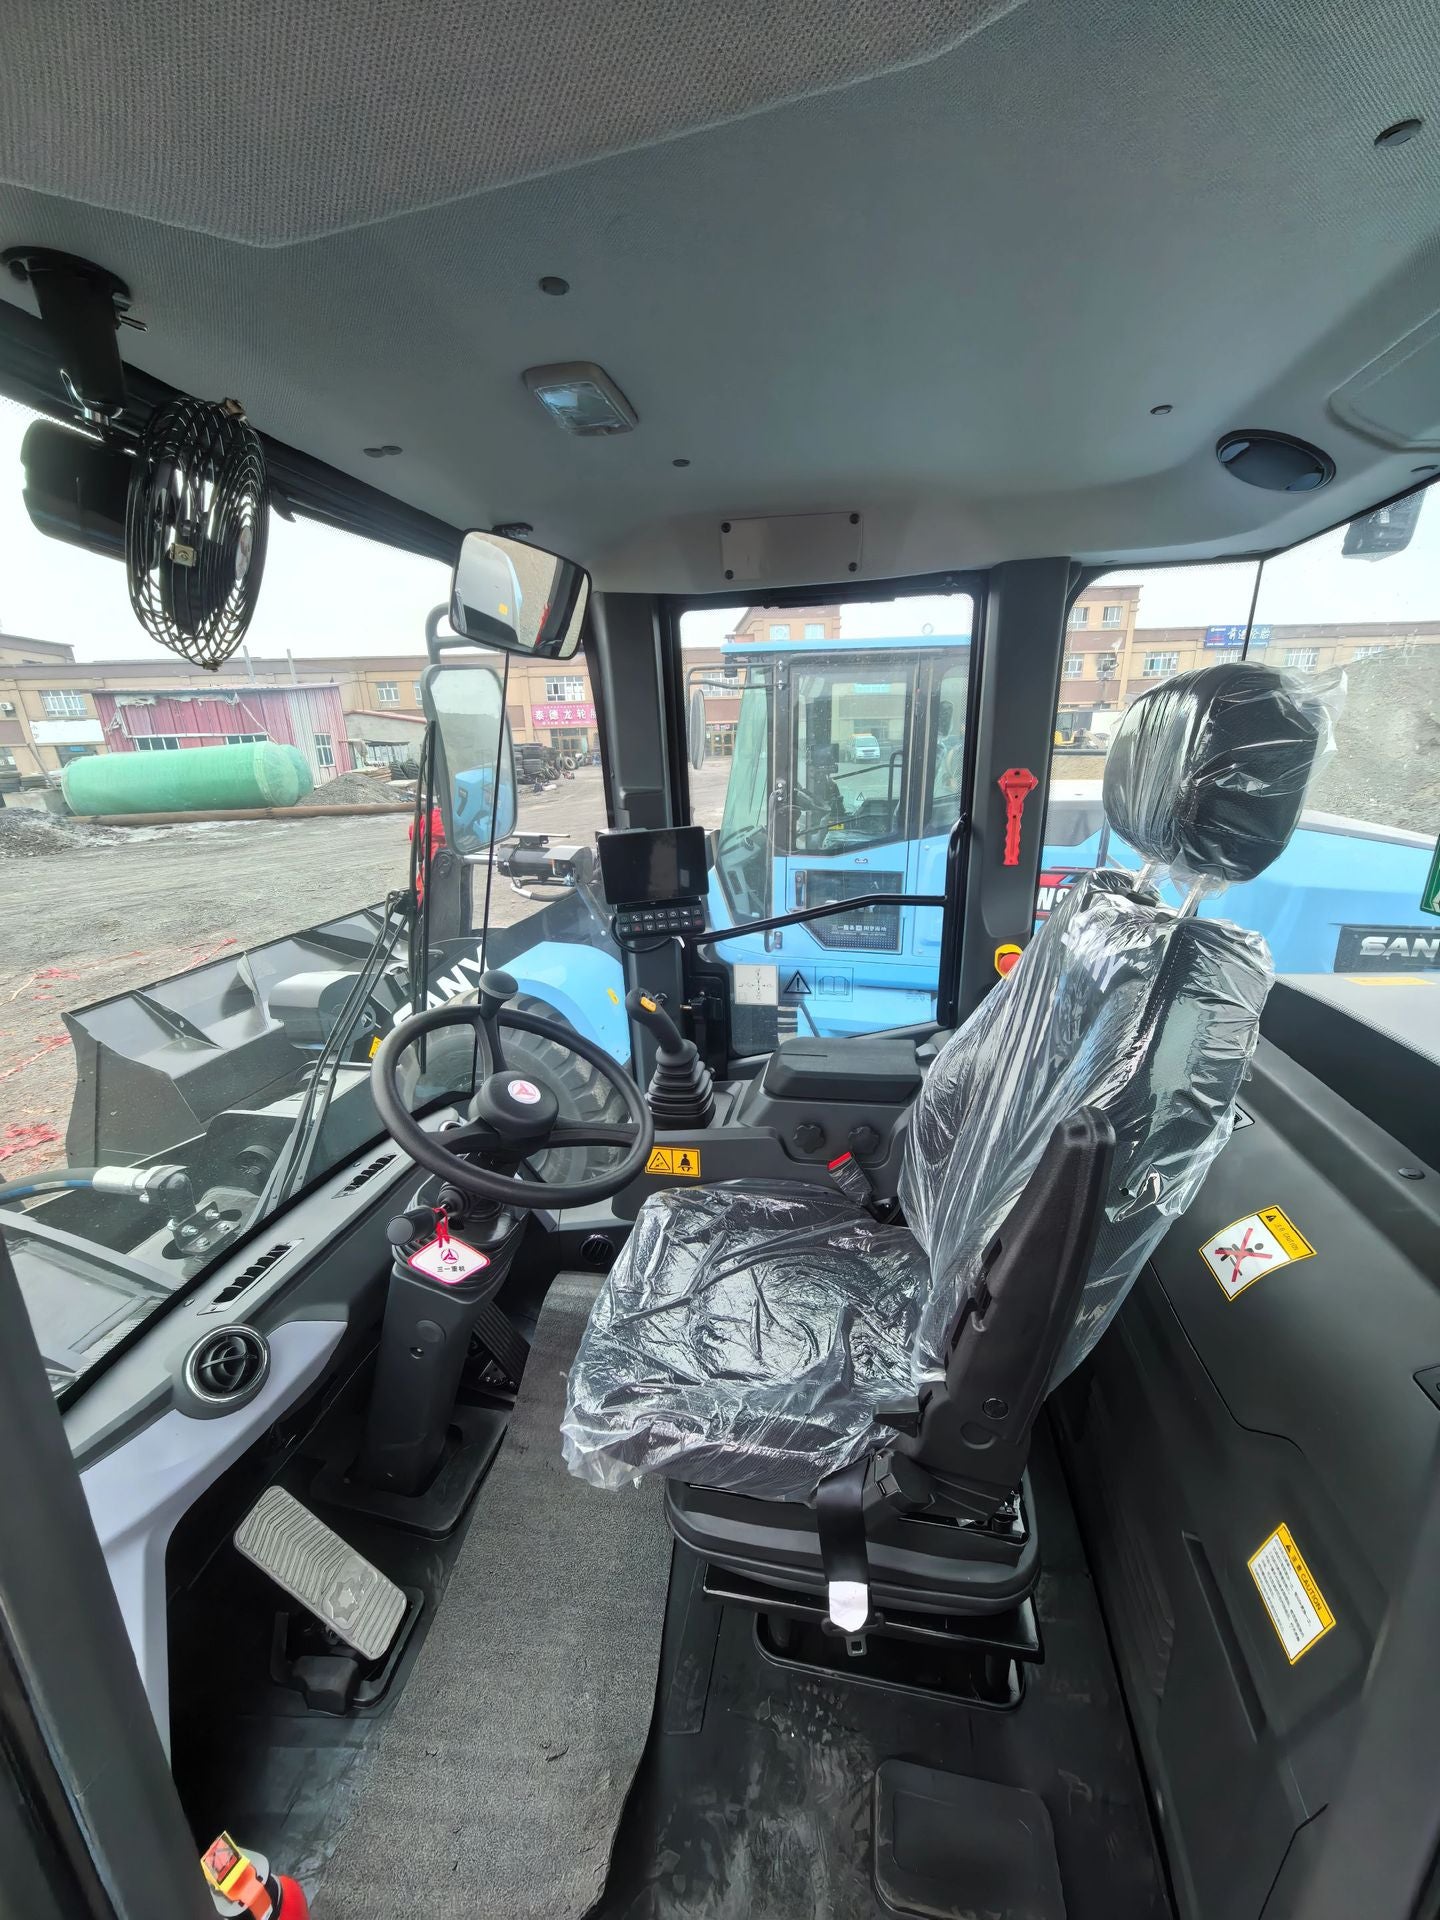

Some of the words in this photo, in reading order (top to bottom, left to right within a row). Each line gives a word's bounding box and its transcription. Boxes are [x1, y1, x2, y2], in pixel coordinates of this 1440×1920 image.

[436, 1265, 466, 1273] 三一重机
[1300, 1573, 1322, 1611] CAUTION
